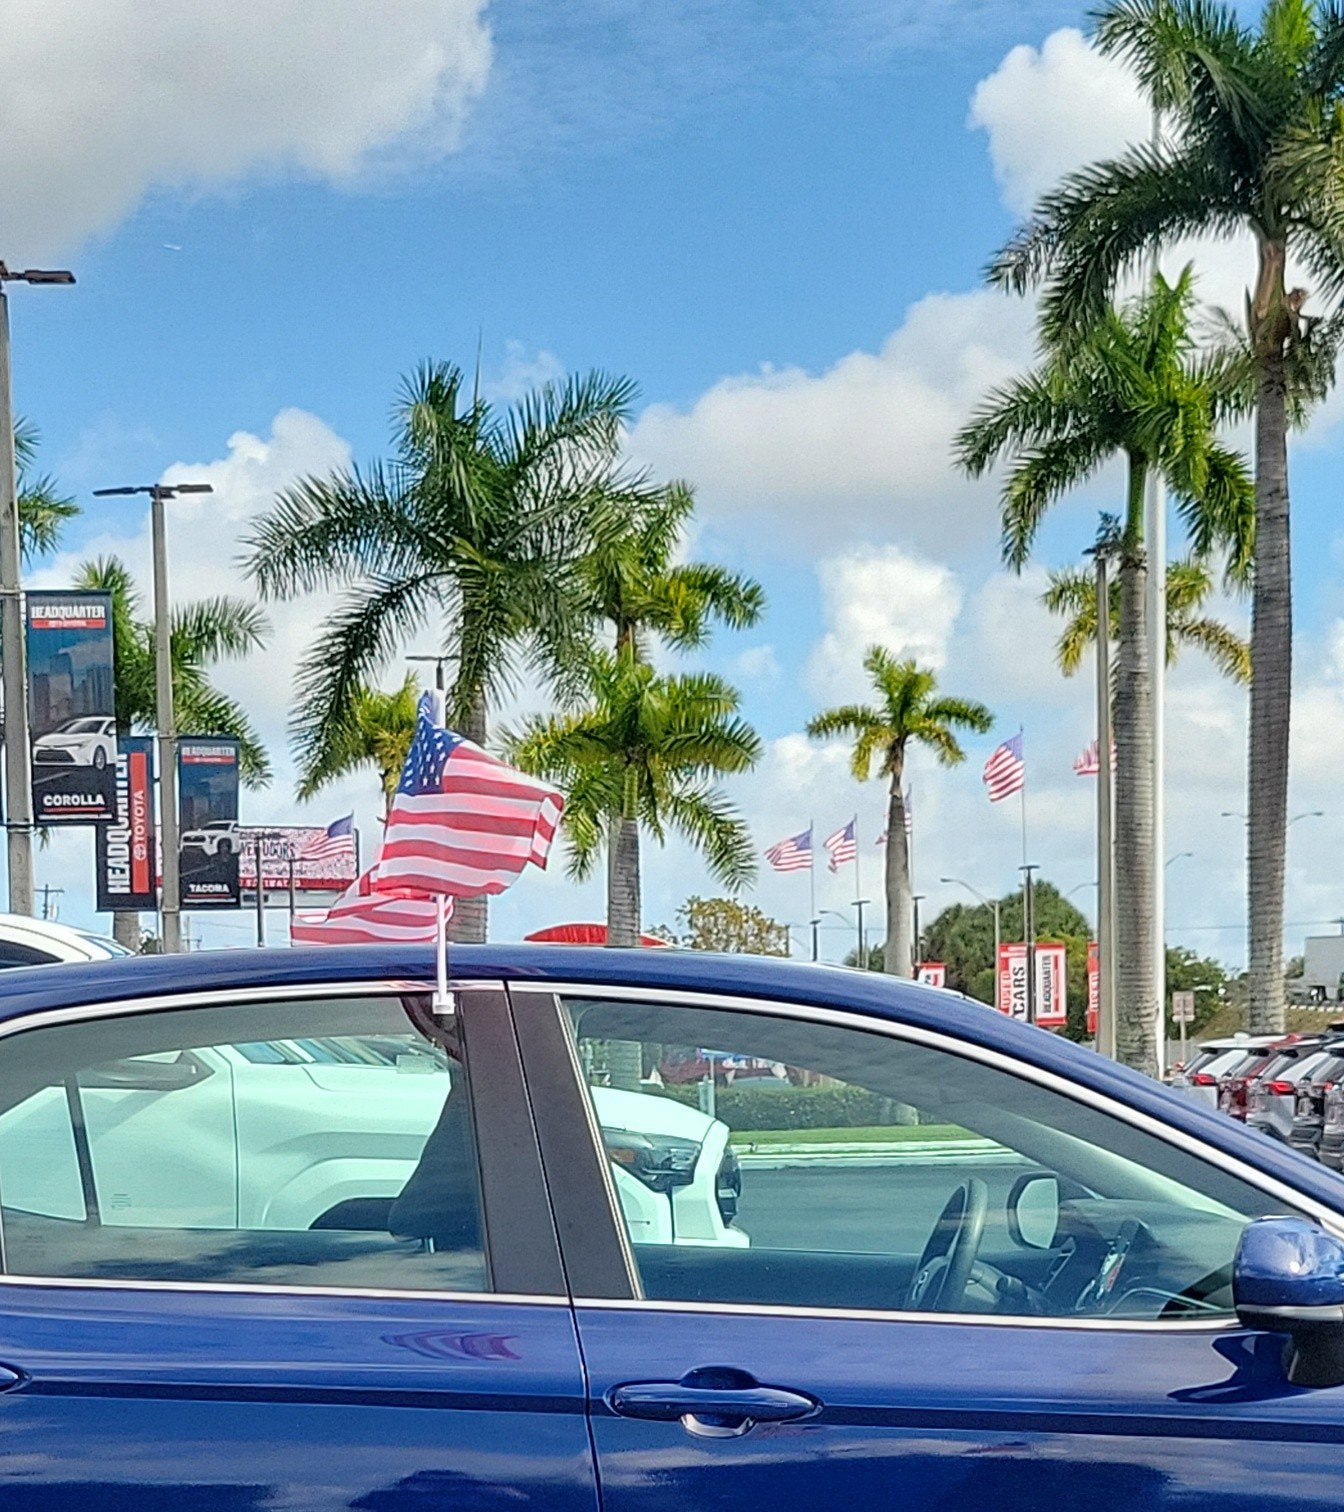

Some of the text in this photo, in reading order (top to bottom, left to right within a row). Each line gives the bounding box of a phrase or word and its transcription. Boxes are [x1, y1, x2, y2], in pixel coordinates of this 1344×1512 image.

[31, 605, 106, 620] HEADQUARTER
[43, 794, 105, 806] COROLLA
[133, 790, 145, 845] TOYOTA
[189, 883, 230, 893] TACOMA
[1012, 966, 1025, 1017] CARS
